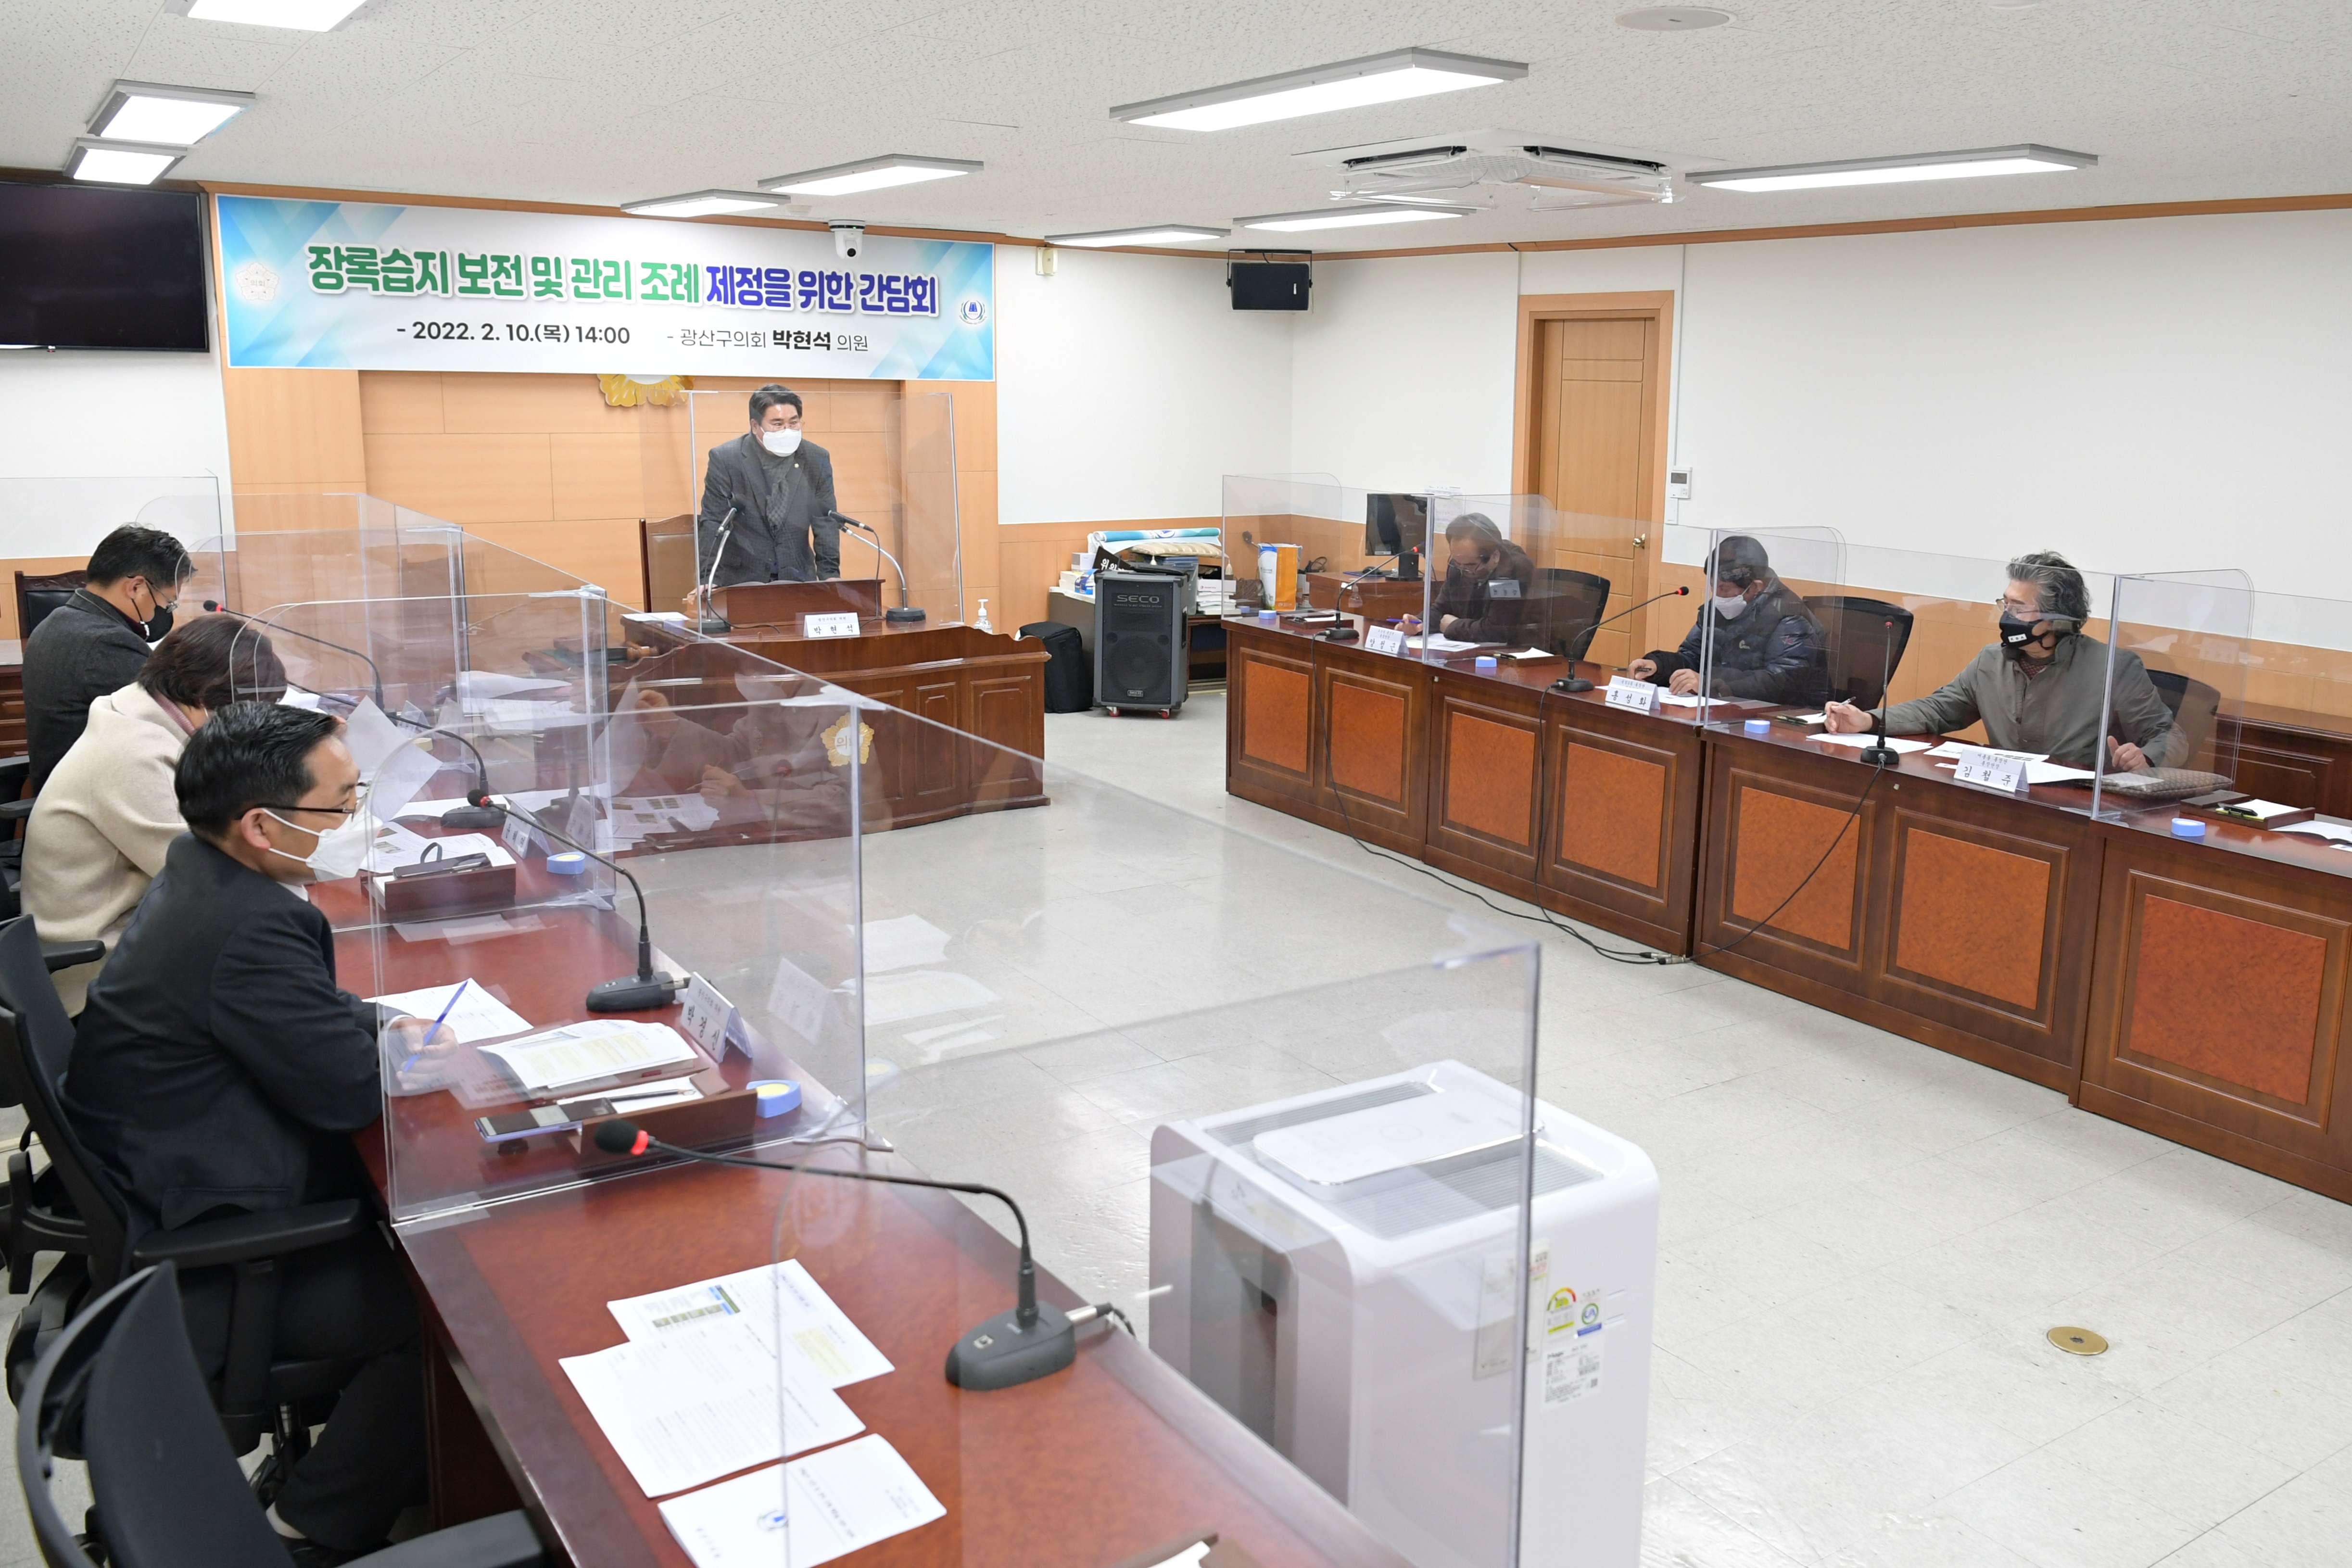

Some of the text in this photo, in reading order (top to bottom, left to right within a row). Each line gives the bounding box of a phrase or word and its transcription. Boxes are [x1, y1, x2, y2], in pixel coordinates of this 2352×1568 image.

[250, 279, 266, 287] 의회
[308, 245, 936, 314] 장록습지 보전 및 관리 조례 제정을 위한 간담회
[412, 321, 475, 340] 2022.
[481, 323, 500, 341] 2.
[506, 323, 570, 343] 10.(목)
[575, 326, 631, 344] 14:00
[680, 329, 766, 348] 광산구의회
[772, 329, 831, 351] 박현석
[837, 334, 869, 352] 의원
[1116, 594, 1160, 604] SECO
